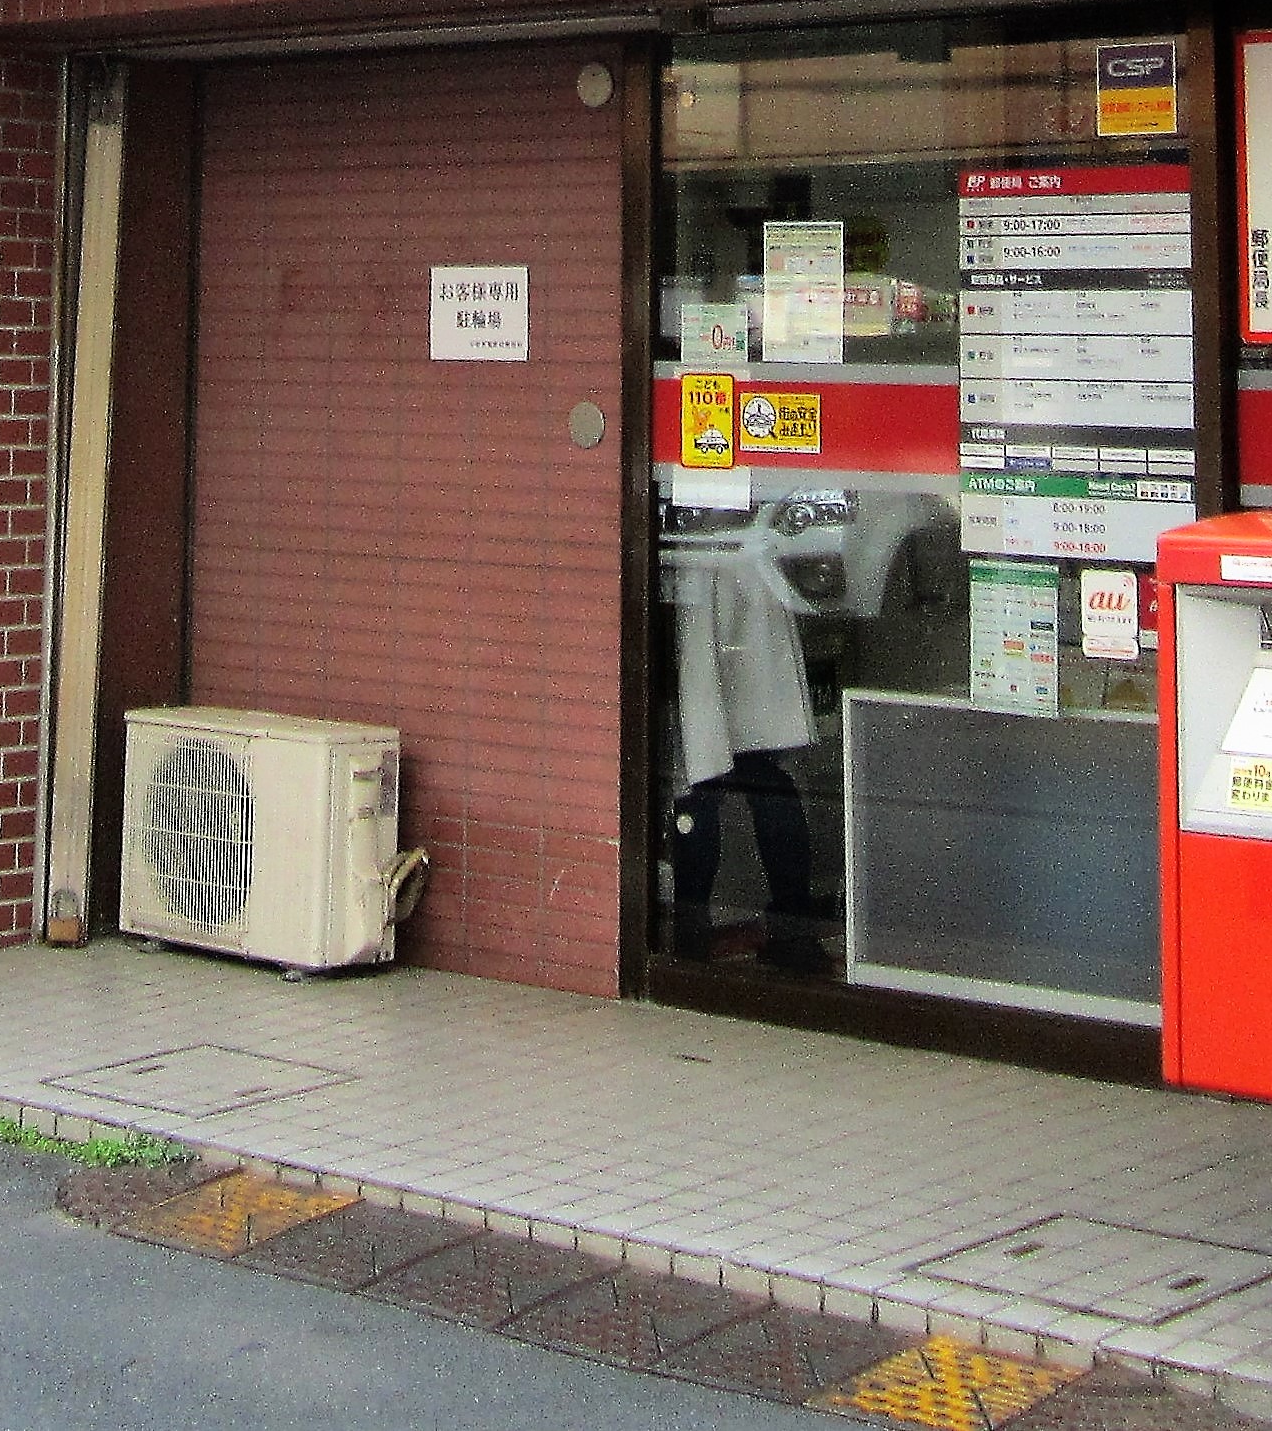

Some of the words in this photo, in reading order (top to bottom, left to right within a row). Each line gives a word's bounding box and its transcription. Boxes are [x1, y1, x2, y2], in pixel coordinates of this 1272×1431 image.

[1003, 219, 1061, 232] 9:00-17:00
[1003, 246, 1061, 259] 9:00-16:00
[439, 281, 519, 302] お客様専用
[455, 309, 502, 329] 駐輪場
[695, 379, 722, 391] こども
[1089, 591, 1131, 611] au
